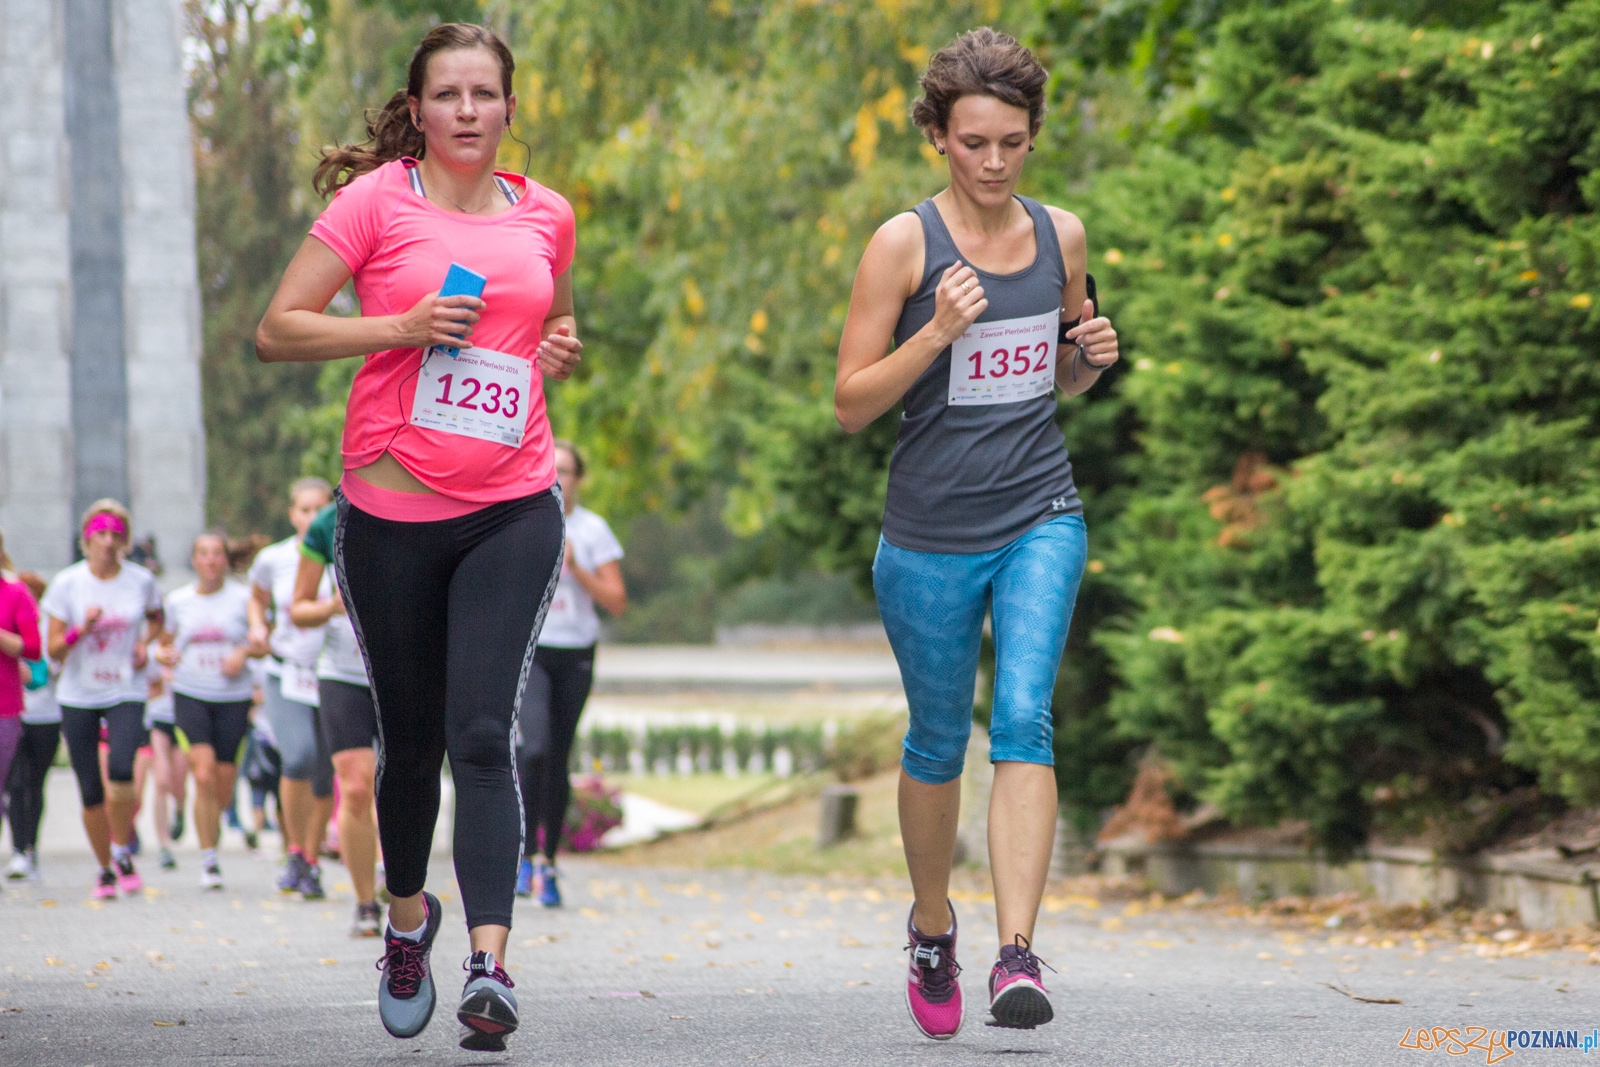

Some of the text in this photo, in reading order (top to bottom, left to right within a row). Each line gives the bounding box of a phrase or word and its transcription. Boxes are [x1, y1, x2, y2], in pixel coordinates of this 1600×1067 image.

[980, 330, 1003, 339] Zawsze
[1032, 323, 1047, 332] 2016
[505, 365, 519, 375] 2016
[968, 341, 1049, 380] 1352
[435, 373, 520, 419] 1233
